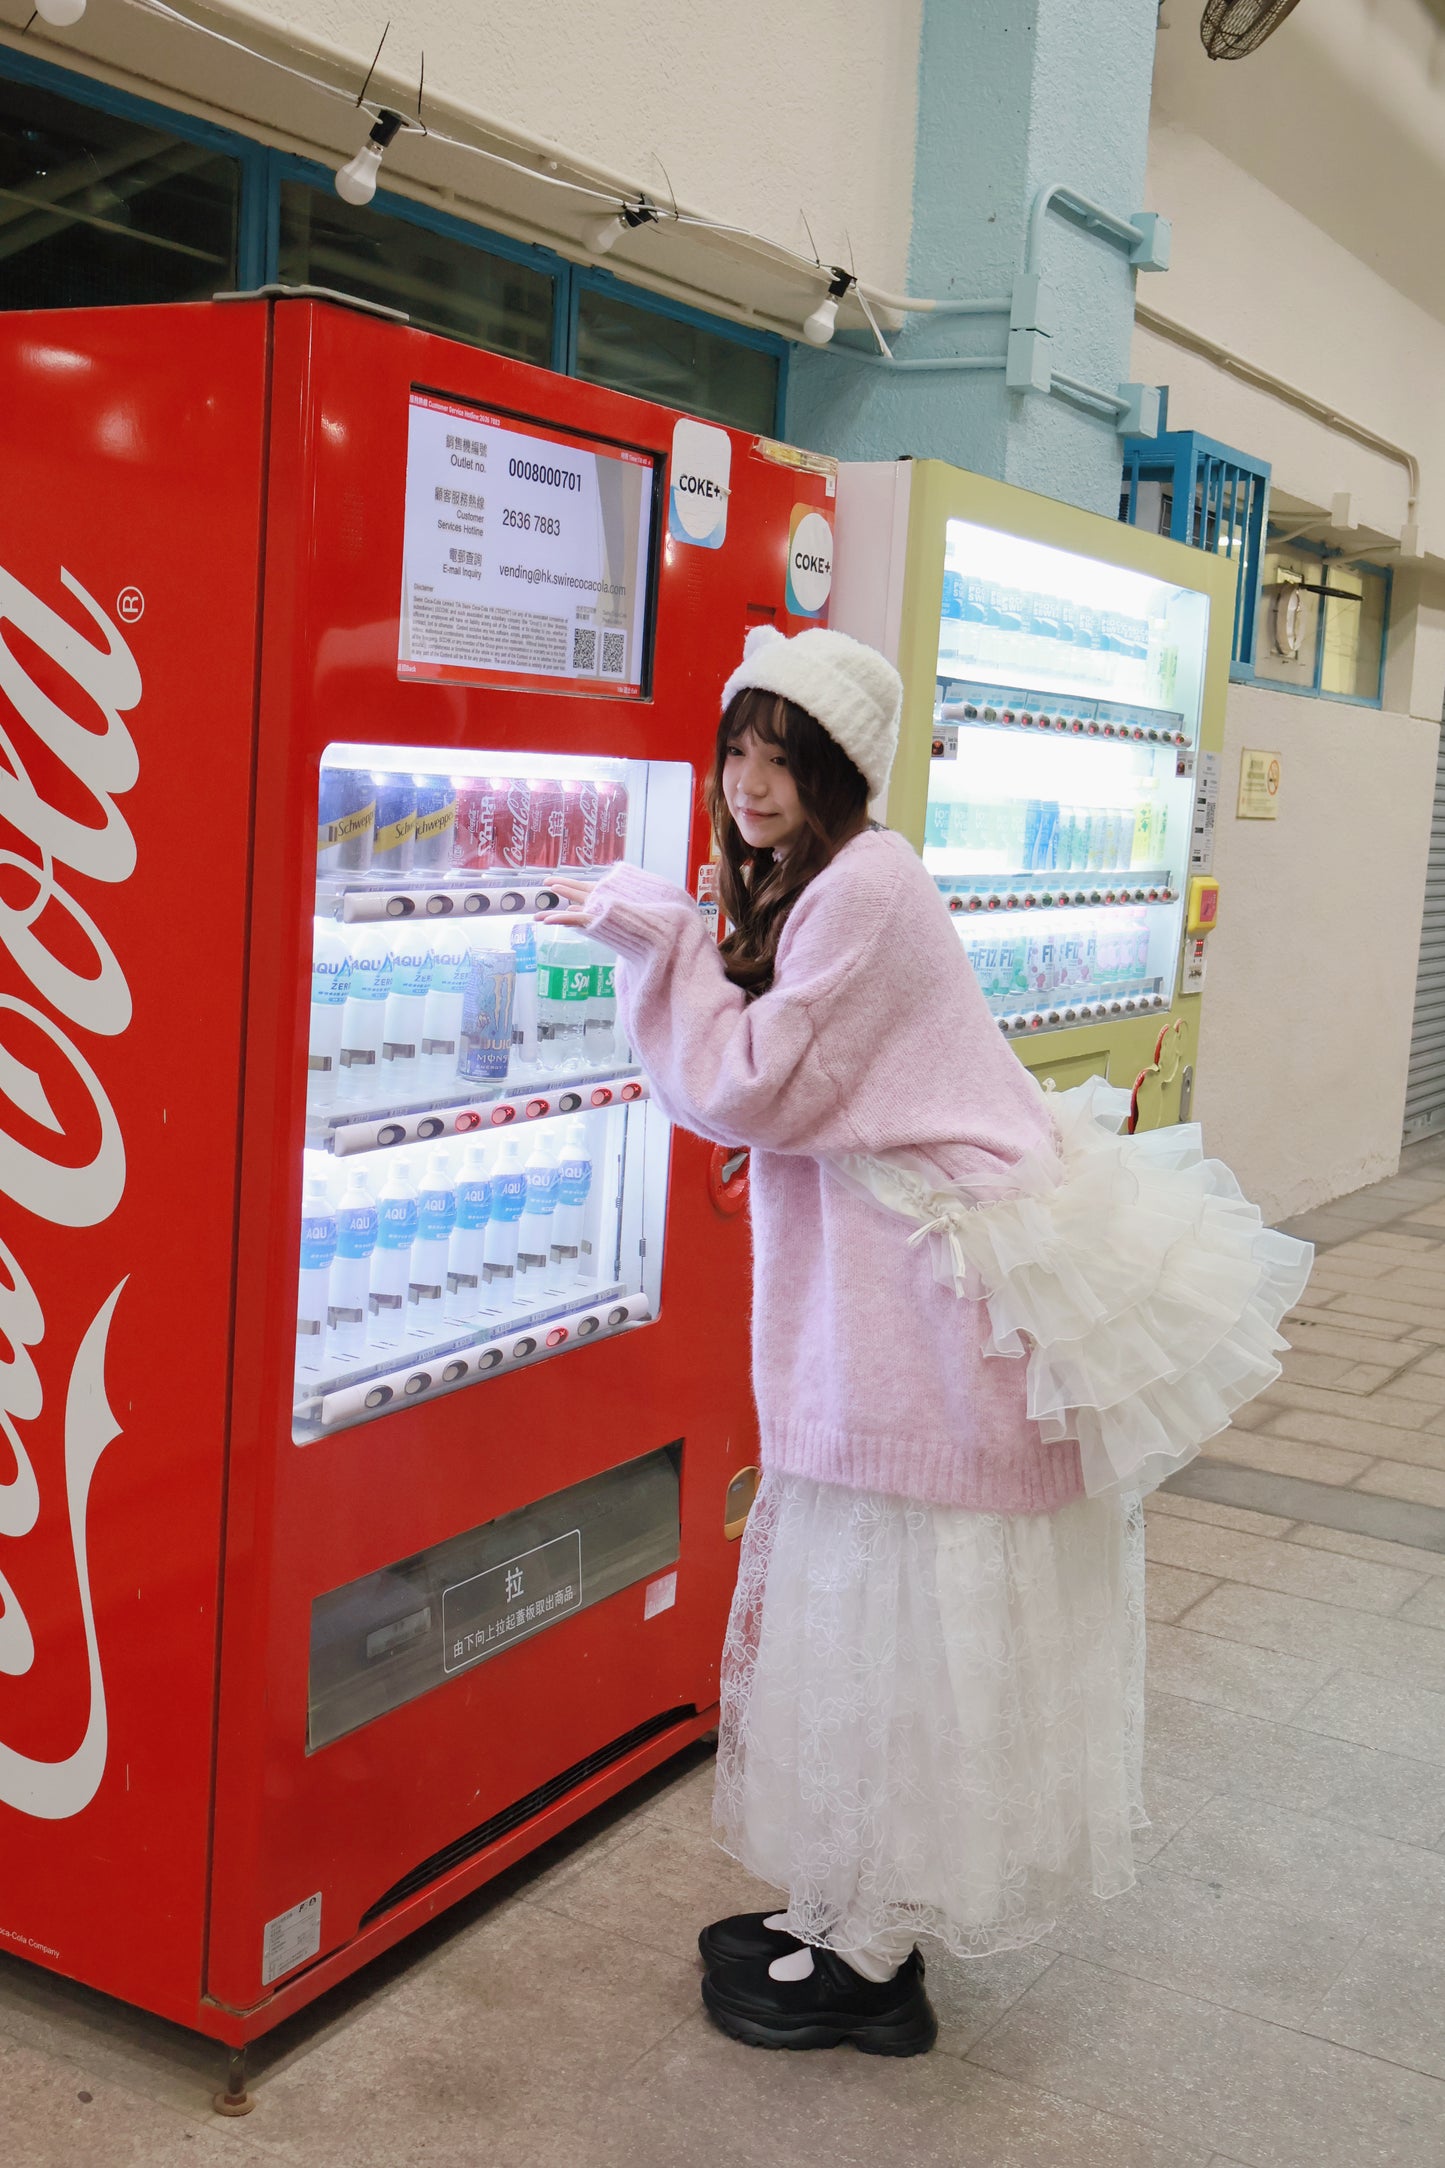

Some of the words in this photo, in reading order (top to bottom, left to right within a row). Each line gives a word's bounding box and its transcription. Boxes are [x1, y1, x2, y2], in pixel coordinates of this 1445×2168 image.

[450, 454, 473, 471] Outlet
[475, 462, 486, 473] no.
[508, 458, 582, 492] 0008000701
[437, 520, 462, 533] Services
[463, 524, 484, 537] Hotline
[456, 510, 484, 523] Customer
[502, 509, 531, 530] 2636
[534, 515, 560, 536] 7883
[442, 563, 461, 576] E-mail
[462, 567, 482, 581] Inquiry
[500, 563, 626, 596] vending@hk.swirecocacola.com
[505, 1566, 525, 1603] 拉
[452, 1585, 575, 1658] 由下向上拉起蓋板取出商品
[28, 1938, 60, 1959] Company
